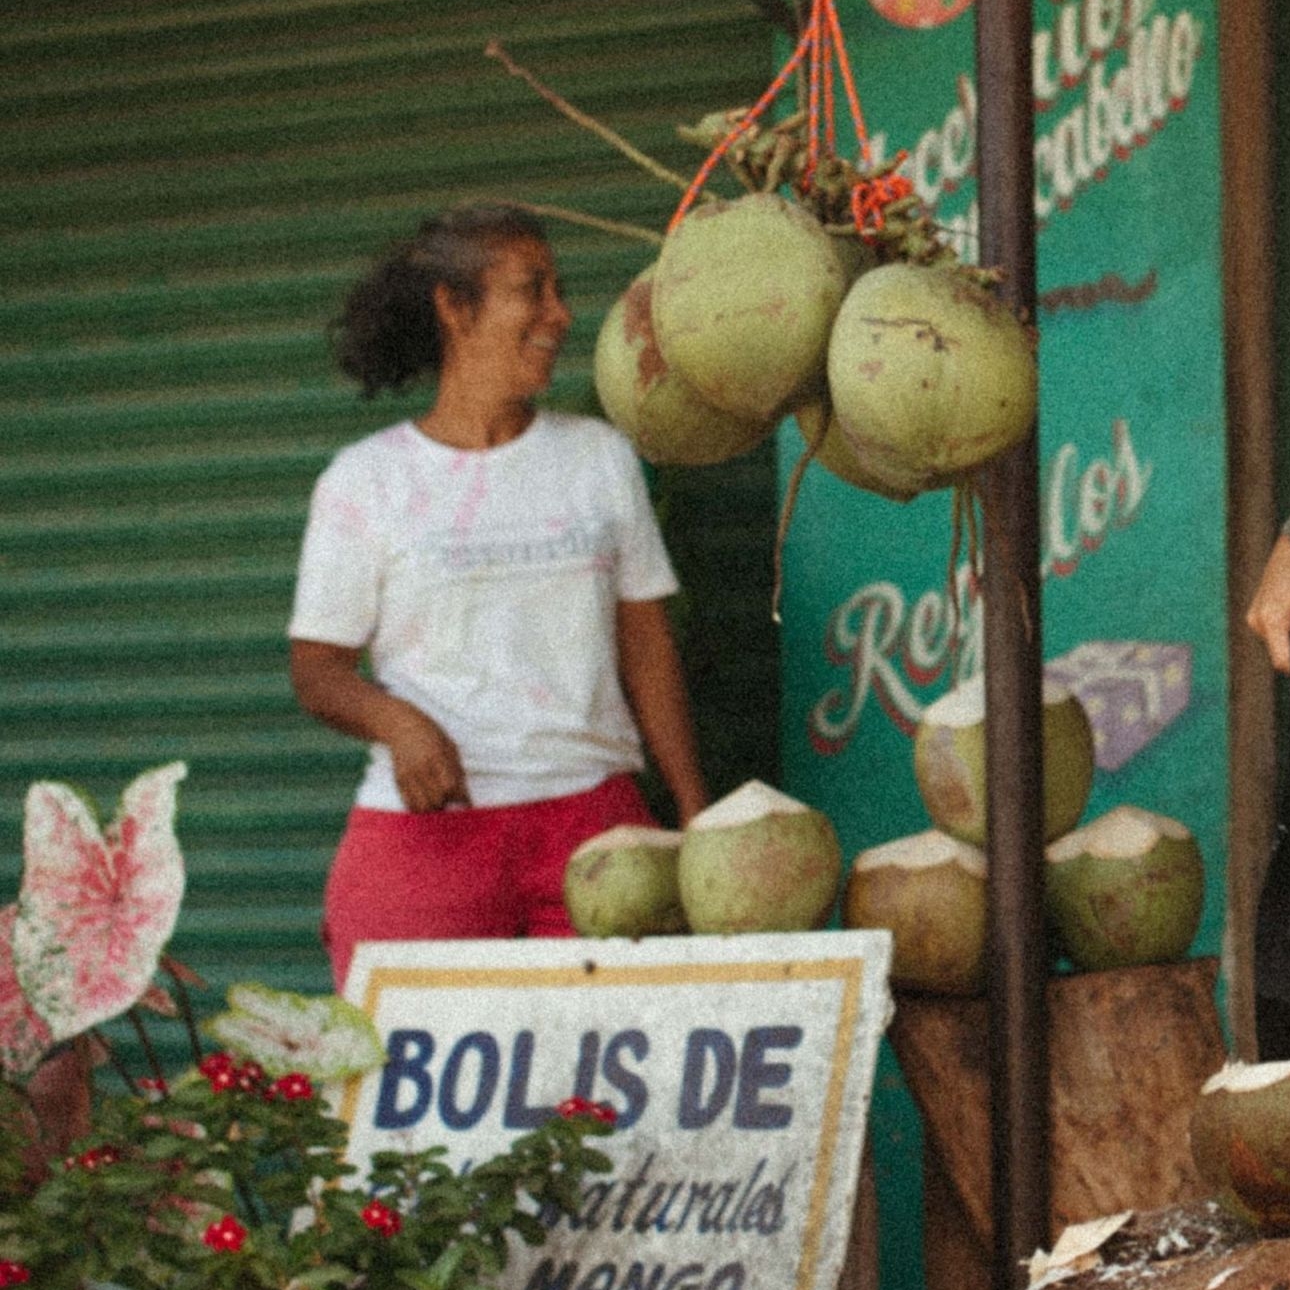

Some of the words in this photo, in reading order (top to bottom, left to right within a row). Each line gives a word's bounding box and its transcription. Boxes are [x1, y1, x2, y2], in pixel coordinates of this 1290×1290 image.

[808, 418, 1152, 756] Reglos
[374, 1027, 652, 1132] BOLIS
[676, 1024, 804, 1131] DE
